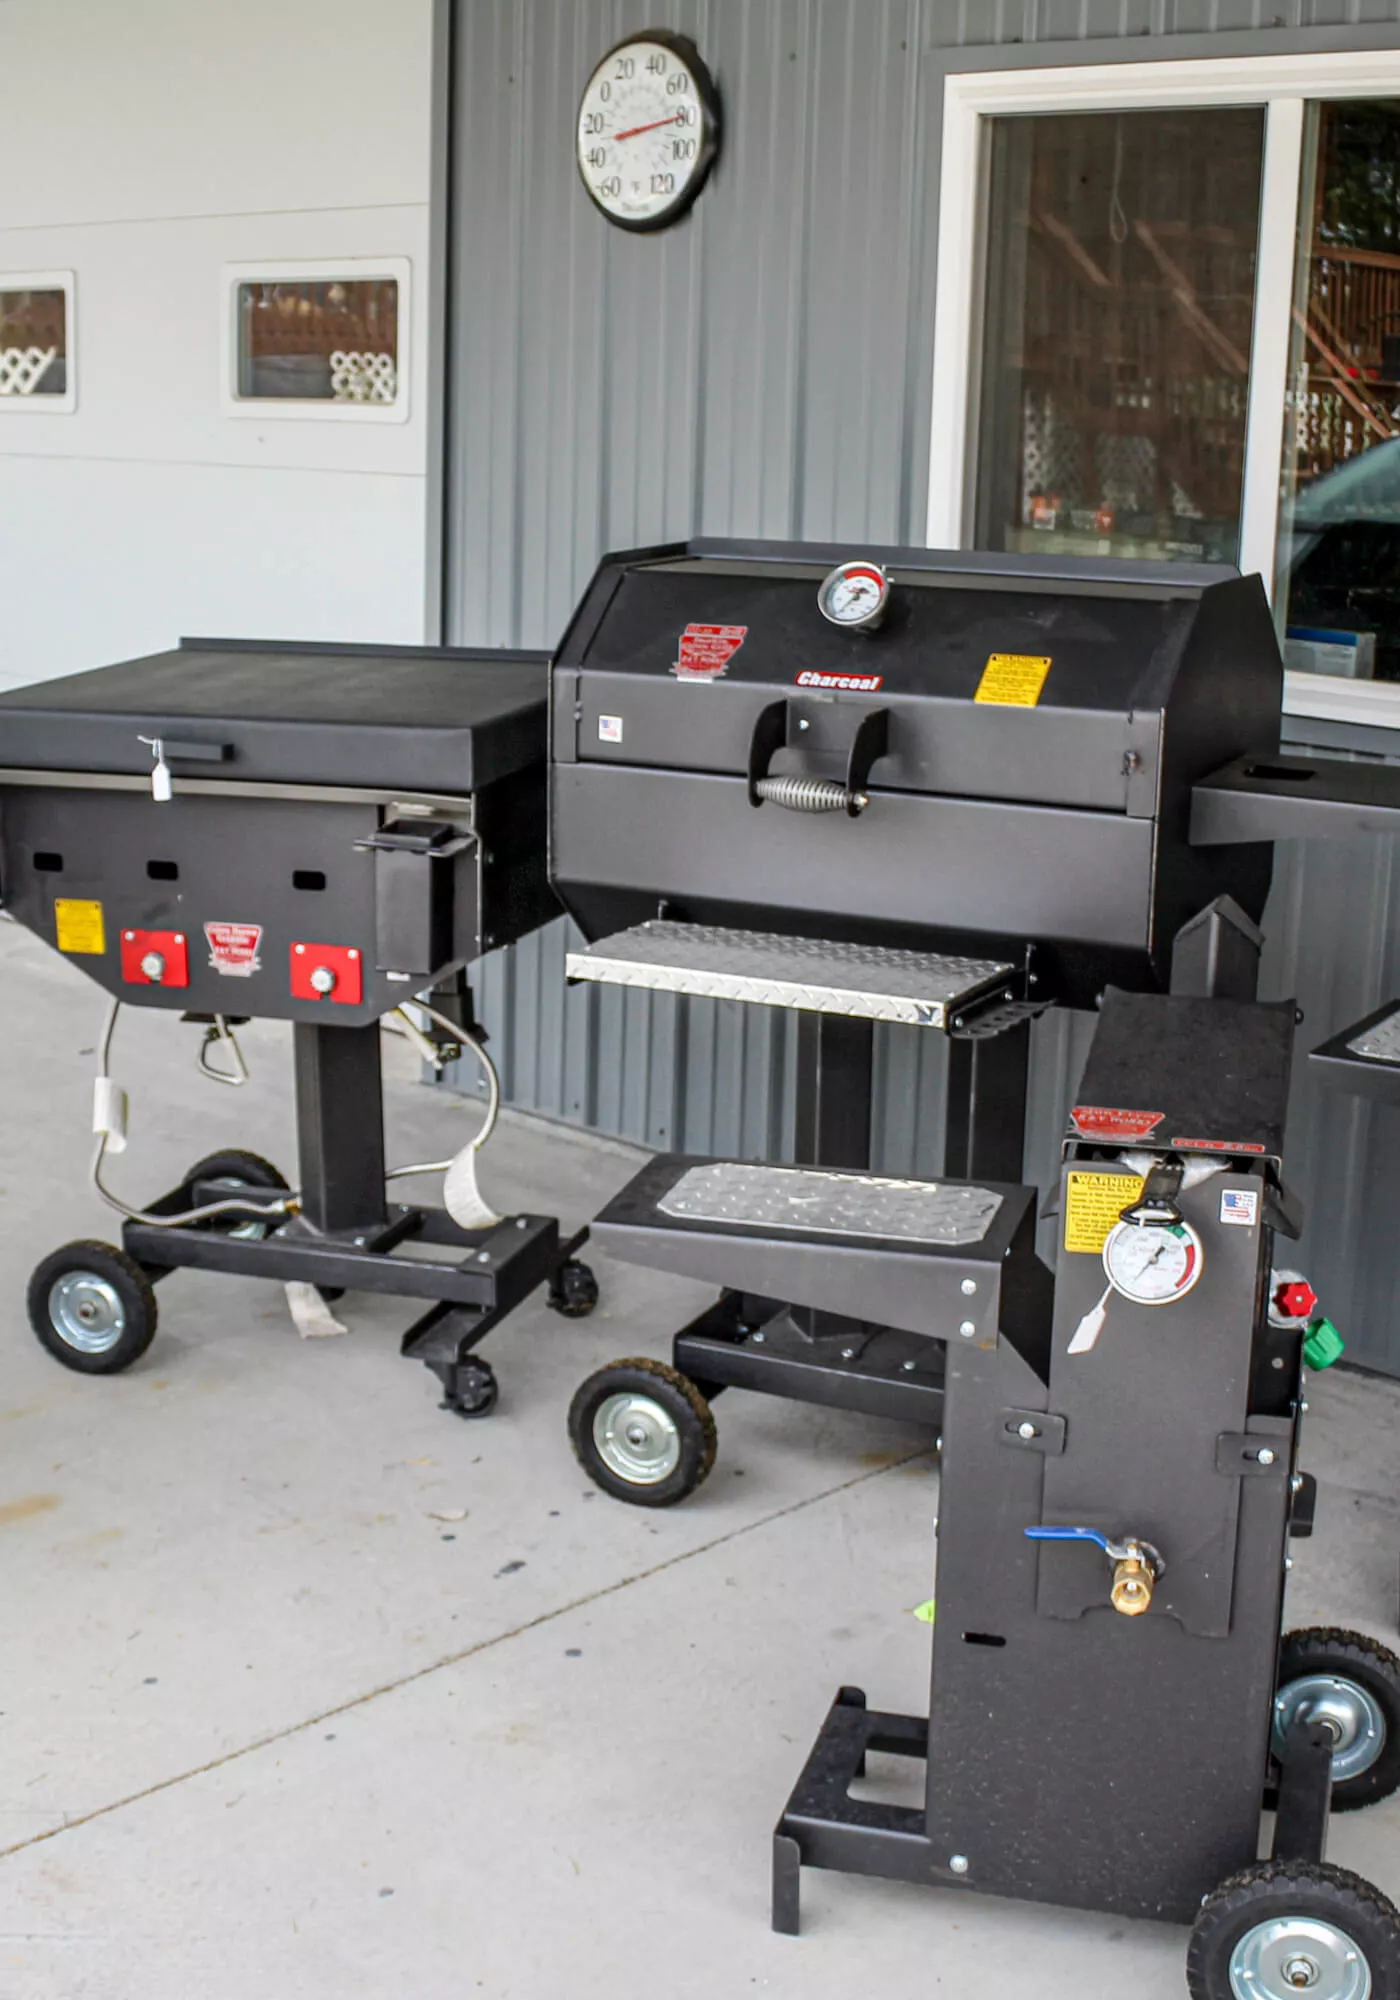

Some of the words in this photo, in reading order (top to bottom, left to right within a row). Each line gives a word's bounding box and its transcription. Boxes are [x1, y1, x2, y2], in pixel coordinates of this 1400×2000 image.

[614, 58, 634, 79] 20
[645, 54, 666, 75] 40
[600, 80, 611, 102] 0
[666, 72, 688, 95] 60
[672, 138, 696, 160] 100
[651, 172, 675, 194] 120
[797, 671, 880, 691] Charcoal
